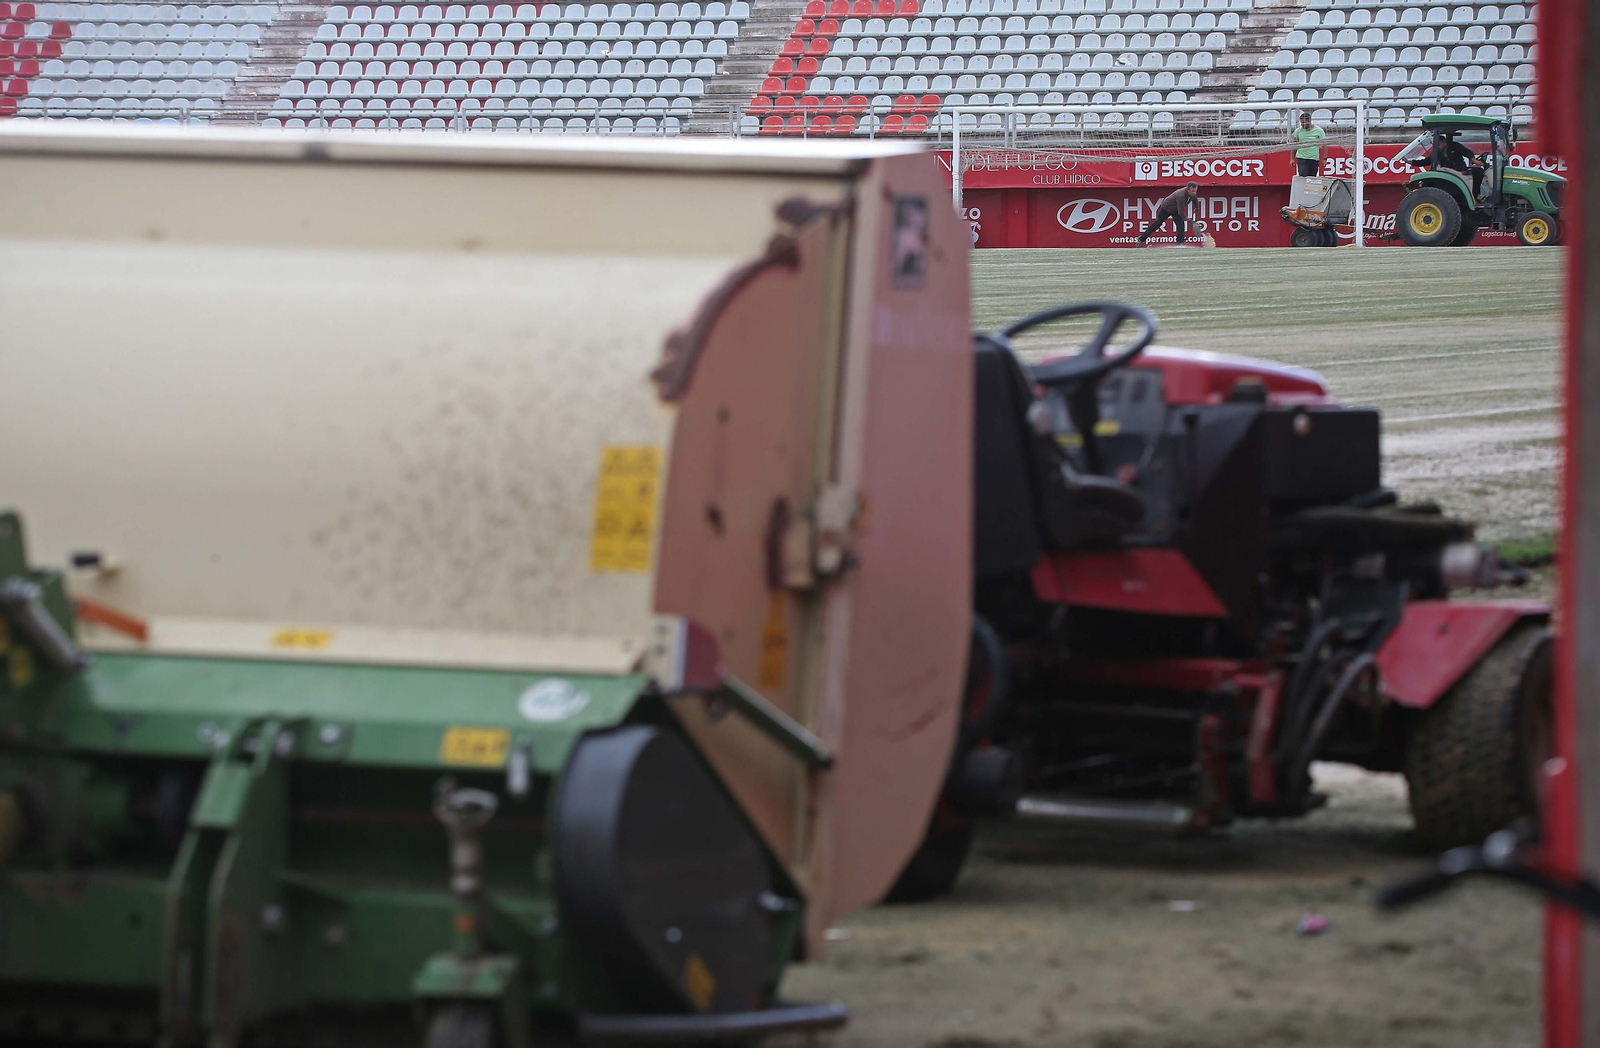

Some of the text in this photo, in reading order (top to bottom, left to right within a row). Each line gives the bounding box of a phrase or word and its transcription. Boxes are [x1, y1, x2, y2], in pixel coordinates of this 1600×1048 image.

[1161, 159, 1264, 177] BESOCCER
[1032, 172, 1101, 185] CLUB HÍPICO
[1123, 196, 1260, 220] HYNDAI
